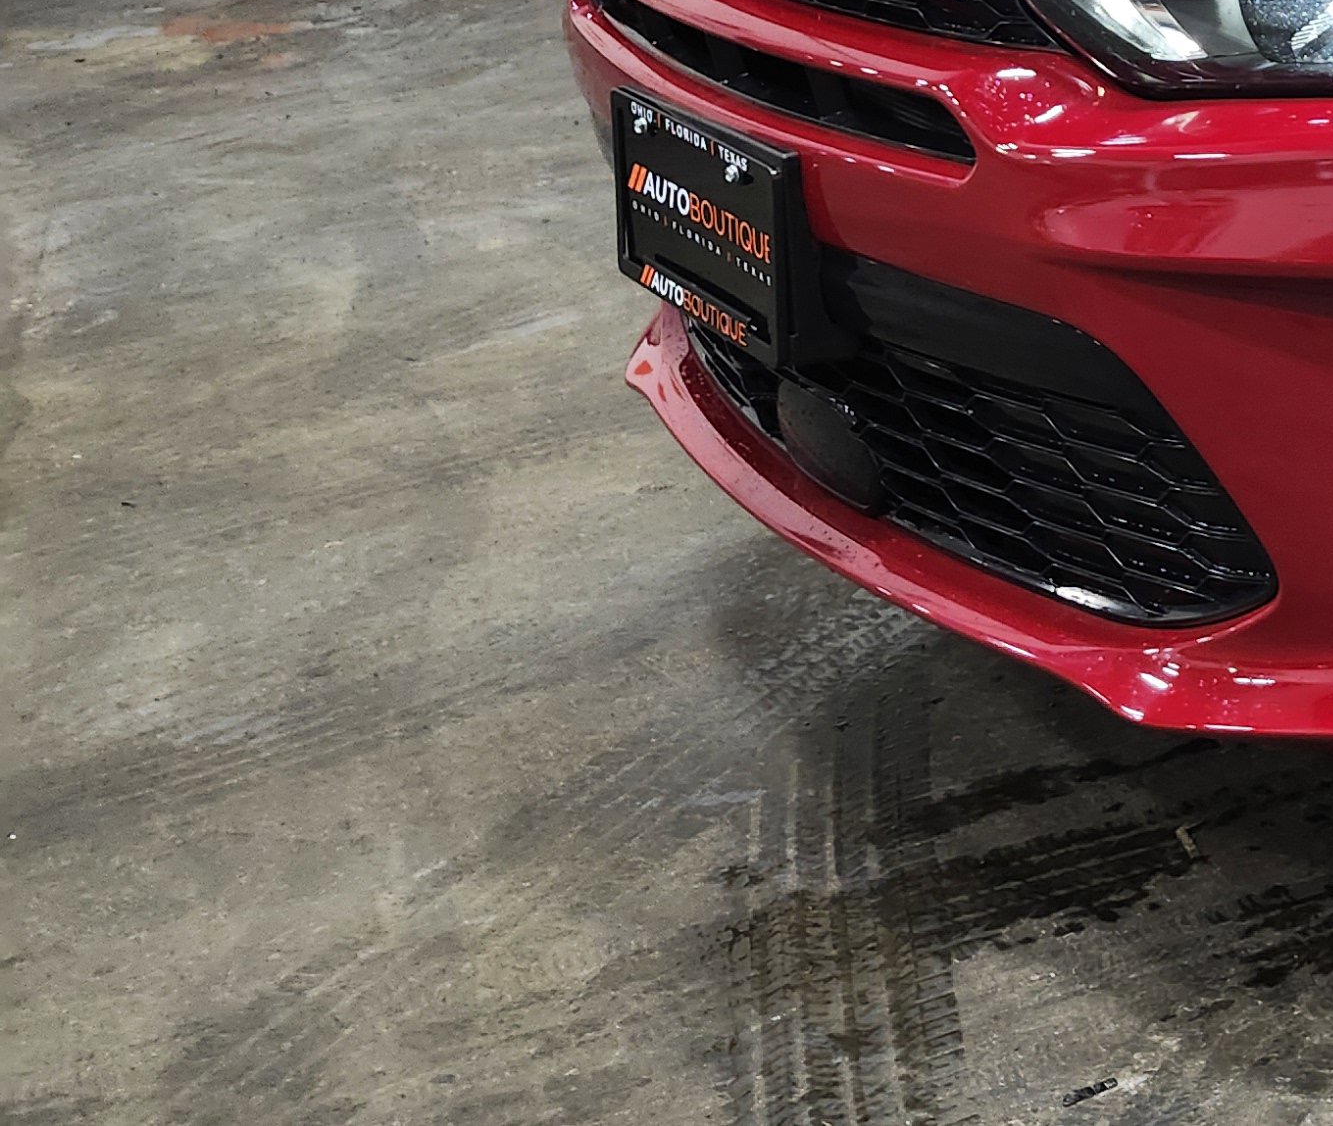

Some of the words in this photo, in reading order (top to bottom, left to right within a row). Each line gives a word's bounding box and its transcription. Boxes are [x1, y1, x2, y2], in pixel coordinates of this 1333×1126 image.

[630, 101, 653, 123] OHIO
[665, 118, 707, 150] FLORIDA
[718, 145, 748, 171] TEXAS
[643, 171, 771, 264] AUTOBOUTIQUE
[672, 221, 721, 255] FLORIDA
[651, 271, 748, 346] AUTOBOUTIQUE
